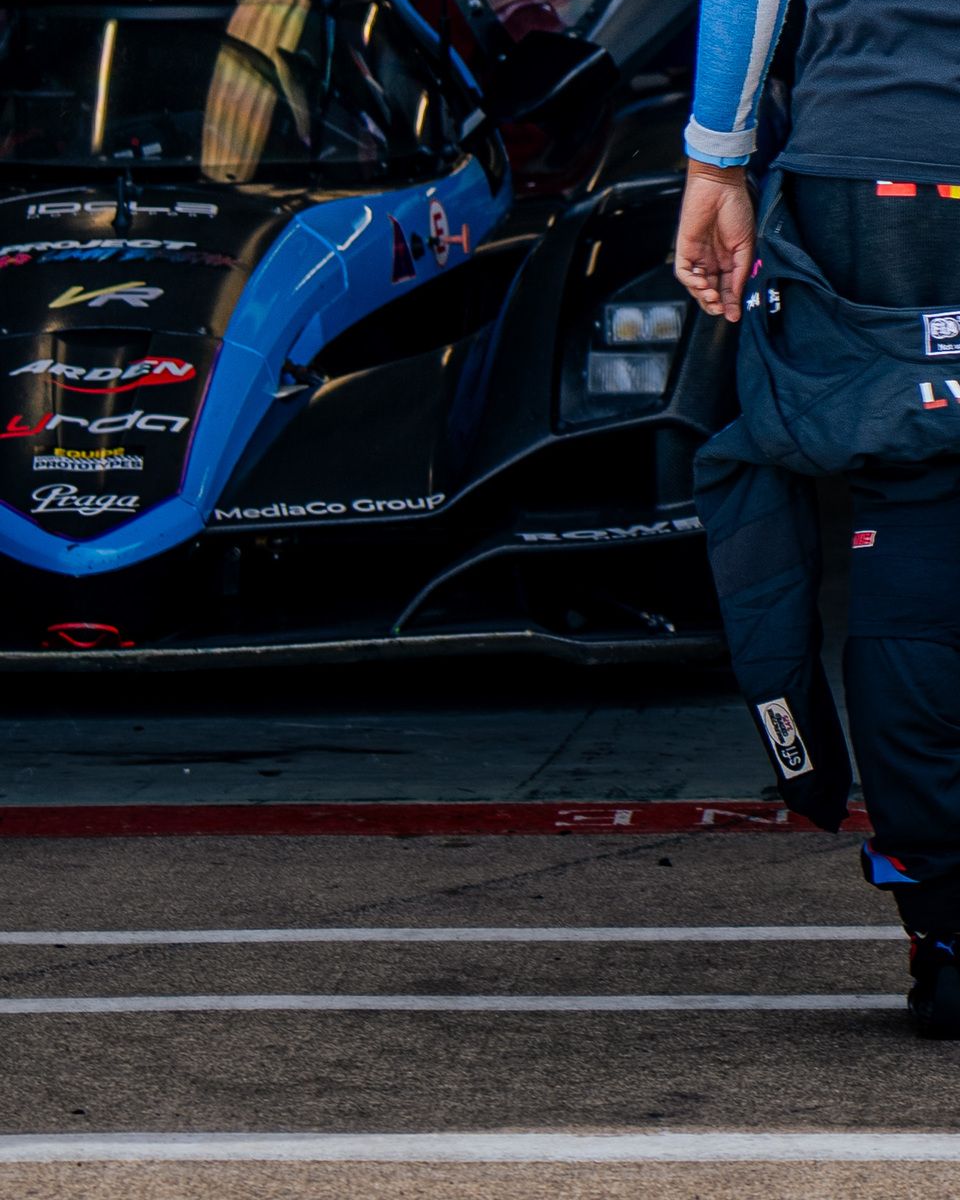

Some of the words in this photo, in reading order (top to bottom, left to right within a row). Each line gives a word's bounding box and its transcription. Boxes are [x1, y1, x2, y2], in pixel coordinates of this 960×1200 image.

[9, 359, 194, 381] ARDEN
[31, 483, 141, 516] Praga
[214, 501, 346, 521] MediaCo
[352, 492, 447, 515] Group
